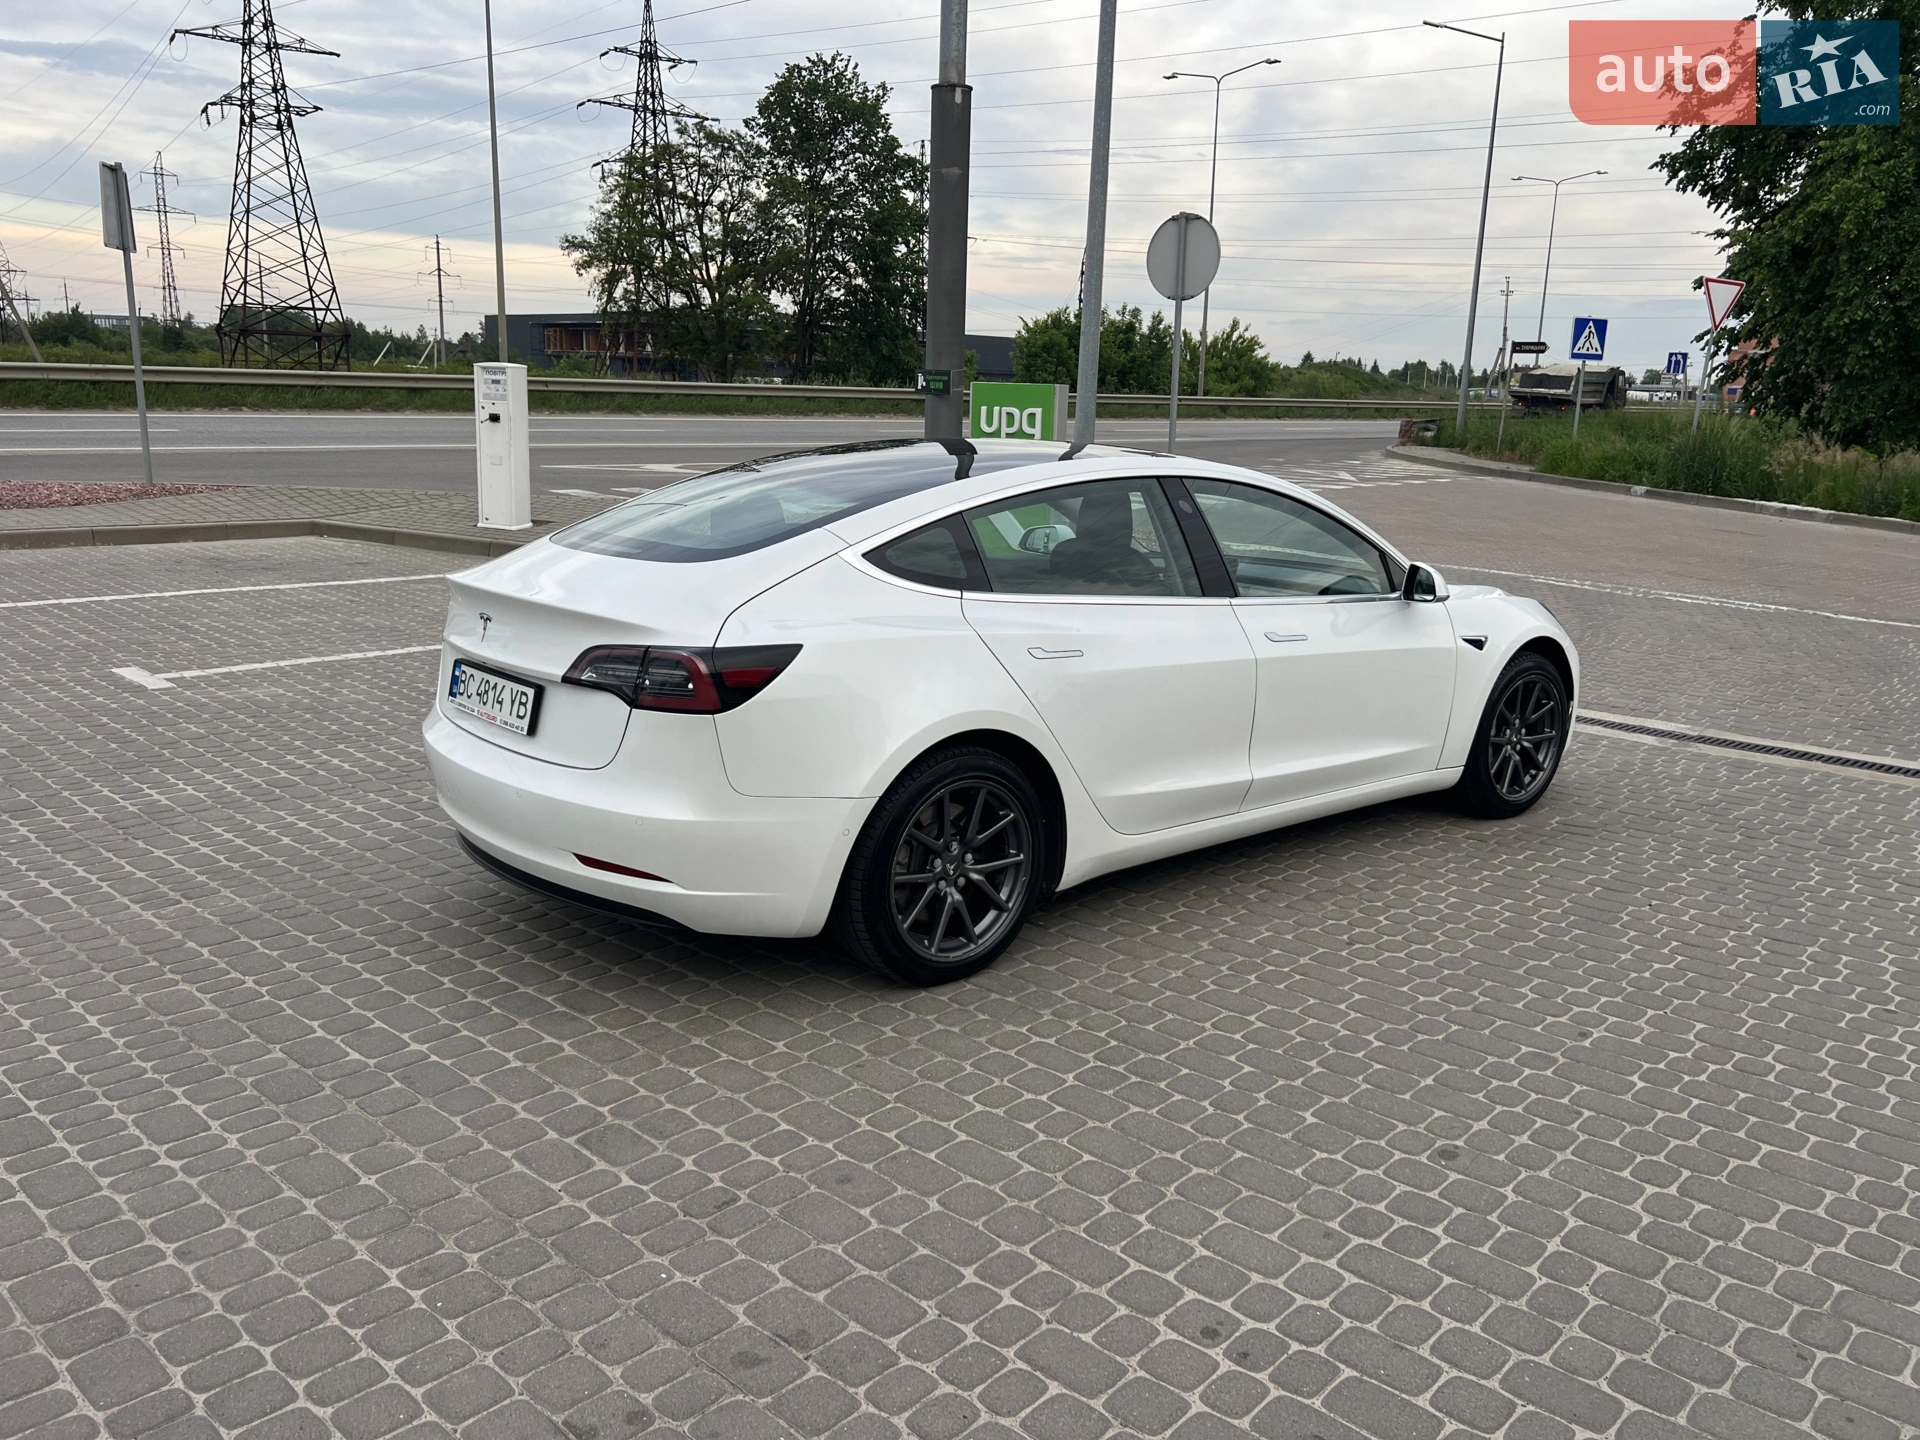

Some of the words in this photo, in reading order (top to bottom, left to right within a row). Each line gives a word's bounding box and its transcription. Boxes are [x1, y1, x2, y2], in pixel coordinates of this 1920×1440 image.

[458, 670, 475, 699] BC
[476, 677, 506, 712] 4814
[509, 687, 529, 720] YB
